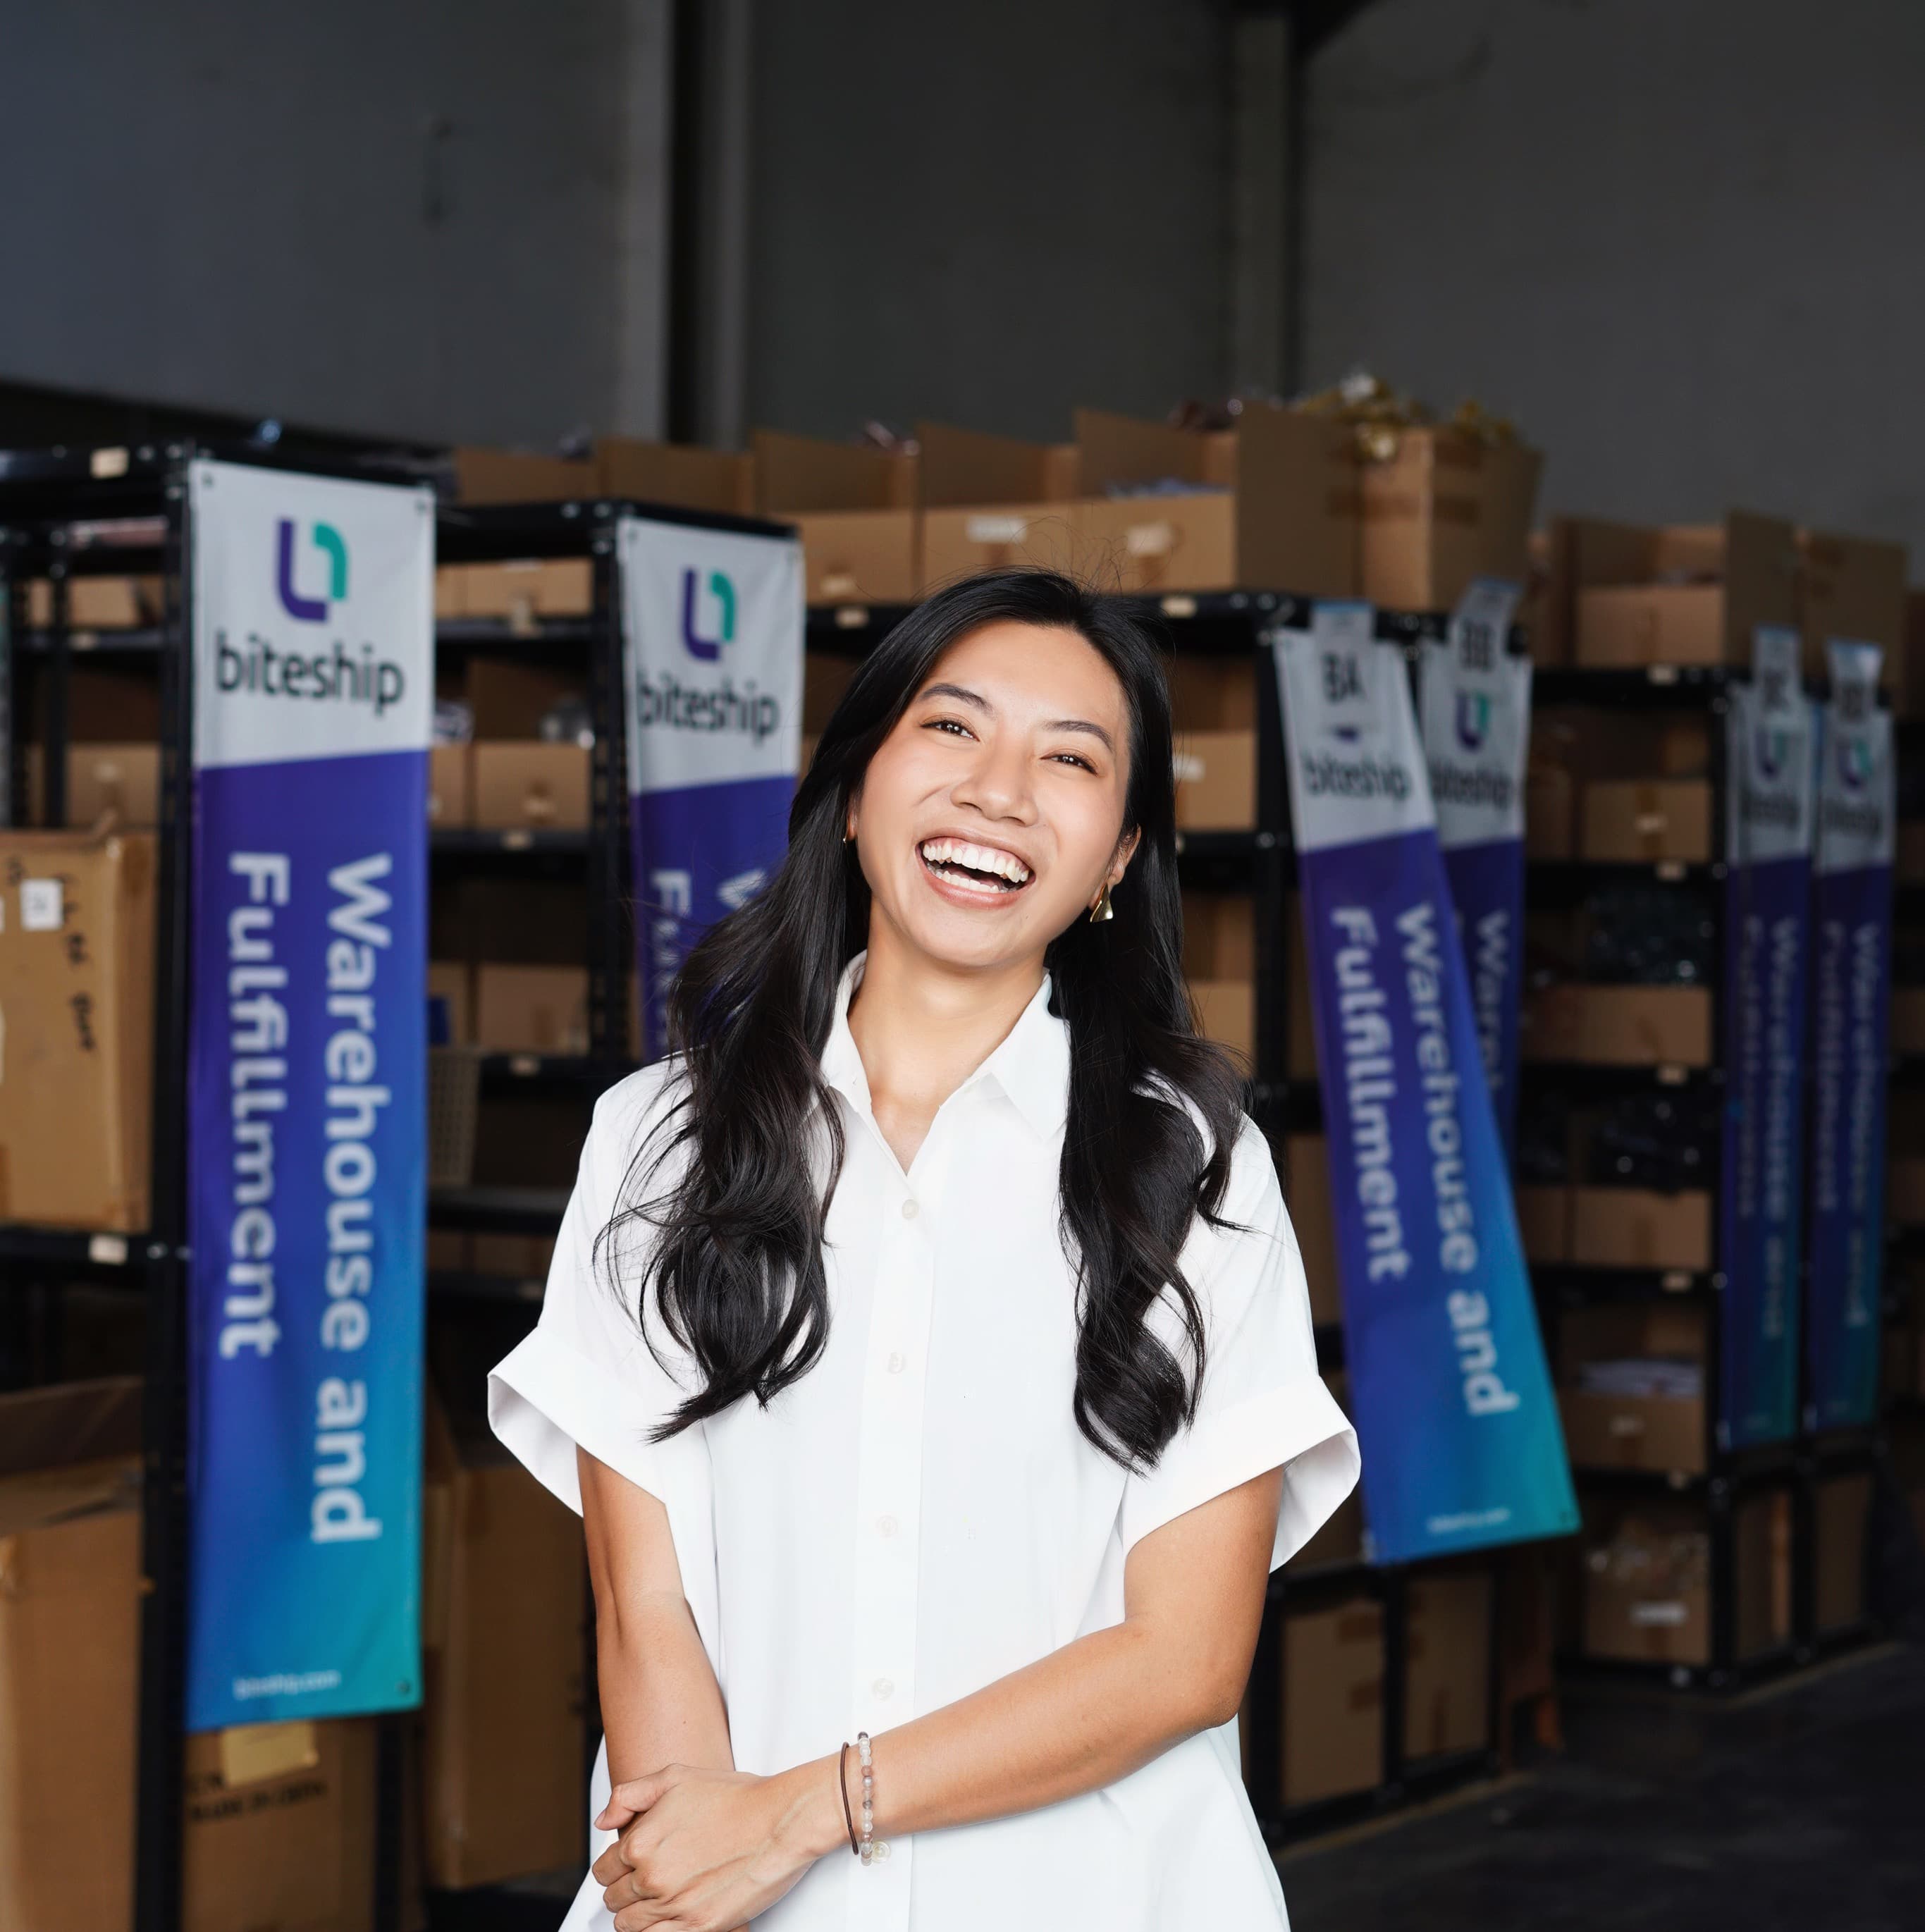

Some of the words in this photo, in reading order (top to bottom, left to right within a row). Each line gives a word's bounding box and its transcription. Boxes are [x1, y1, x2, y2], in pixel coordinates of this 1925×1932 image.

[216, 629, 405, 718] biteship
[637, 665, 780, 748] biteship
[1322, 652, 1364, 703] BA
[219, 852, 290, 1360] Fulfillment
[320, 852, 392, 1351] Warehouse
[1331, 907, 1411, 1282] Fulfillment
[1396, 901, 1477, 1274] Warehouse
[1448, 1290, 1519, 1416] and
[310, 1377, 383, 1544] and
